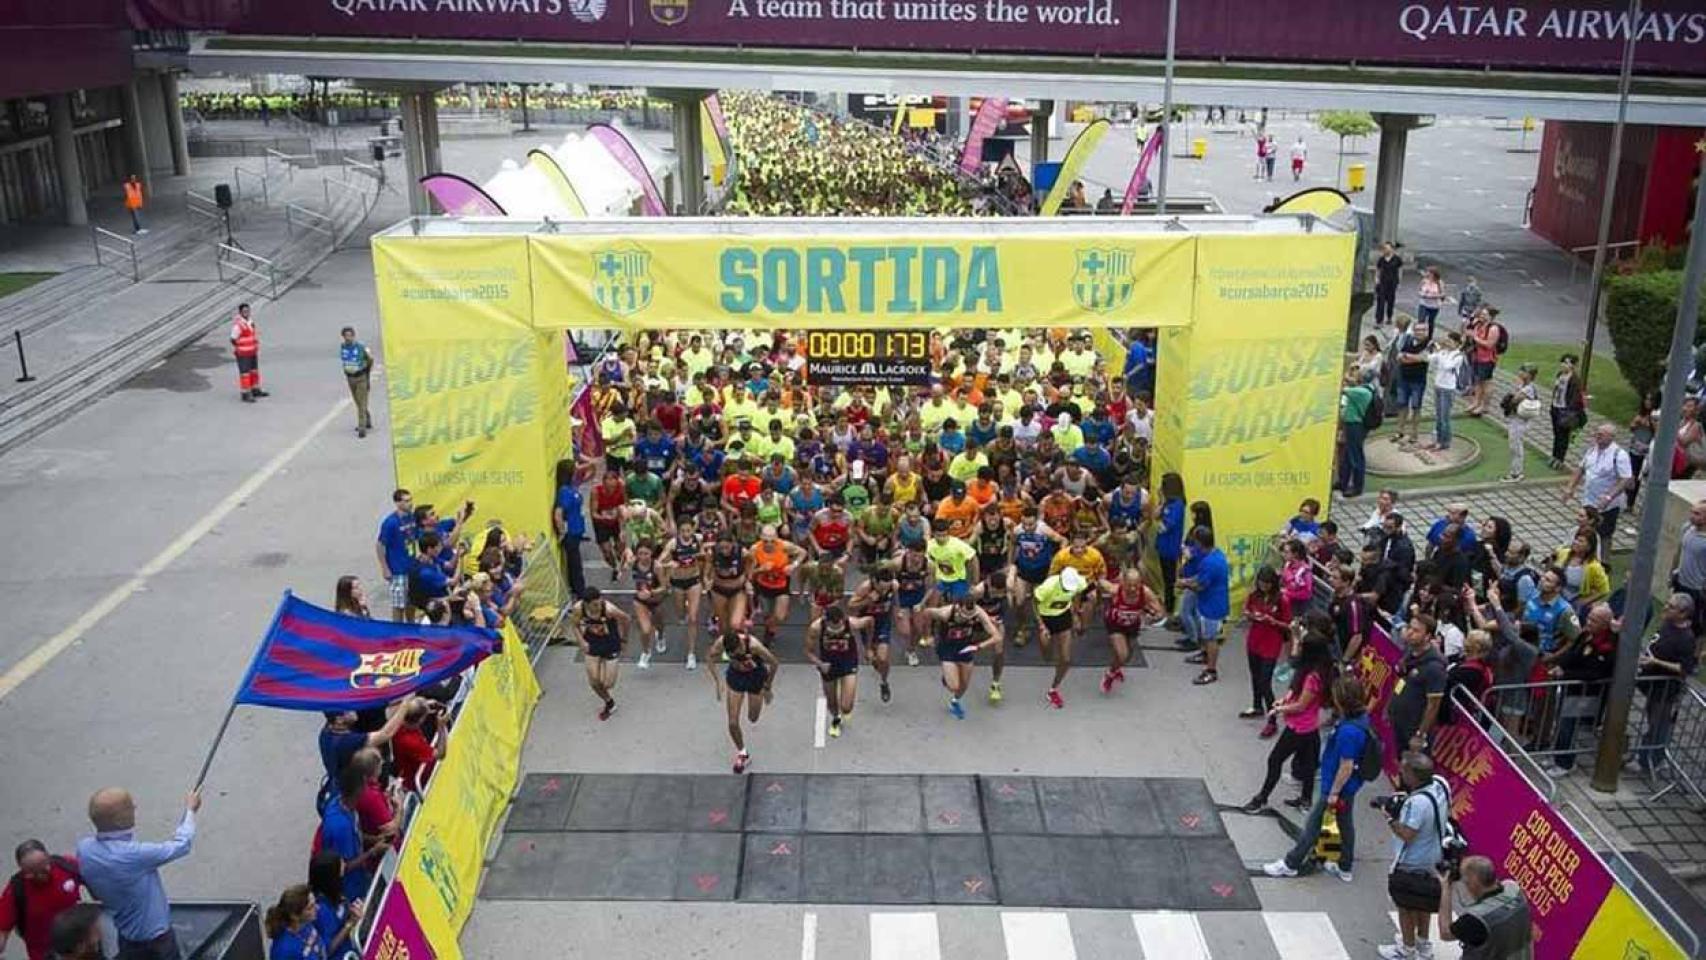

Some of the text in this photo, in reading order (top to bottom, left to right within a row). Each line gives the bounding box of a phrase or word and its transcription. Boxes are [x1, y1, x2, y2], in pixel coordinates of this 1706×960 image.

[727, 0, 1121, 26] A team that unites the world.
[1399, 4, 1706, 43] QATAR AIRWAYS
[720, 246, 1003, 313] SORTIDA
[1431, 723, 1496, 786] URSA
[1509, 822, 1574, 904] FOC ALS PEUS
[1526, 809, 1581, 878] COR CULER
